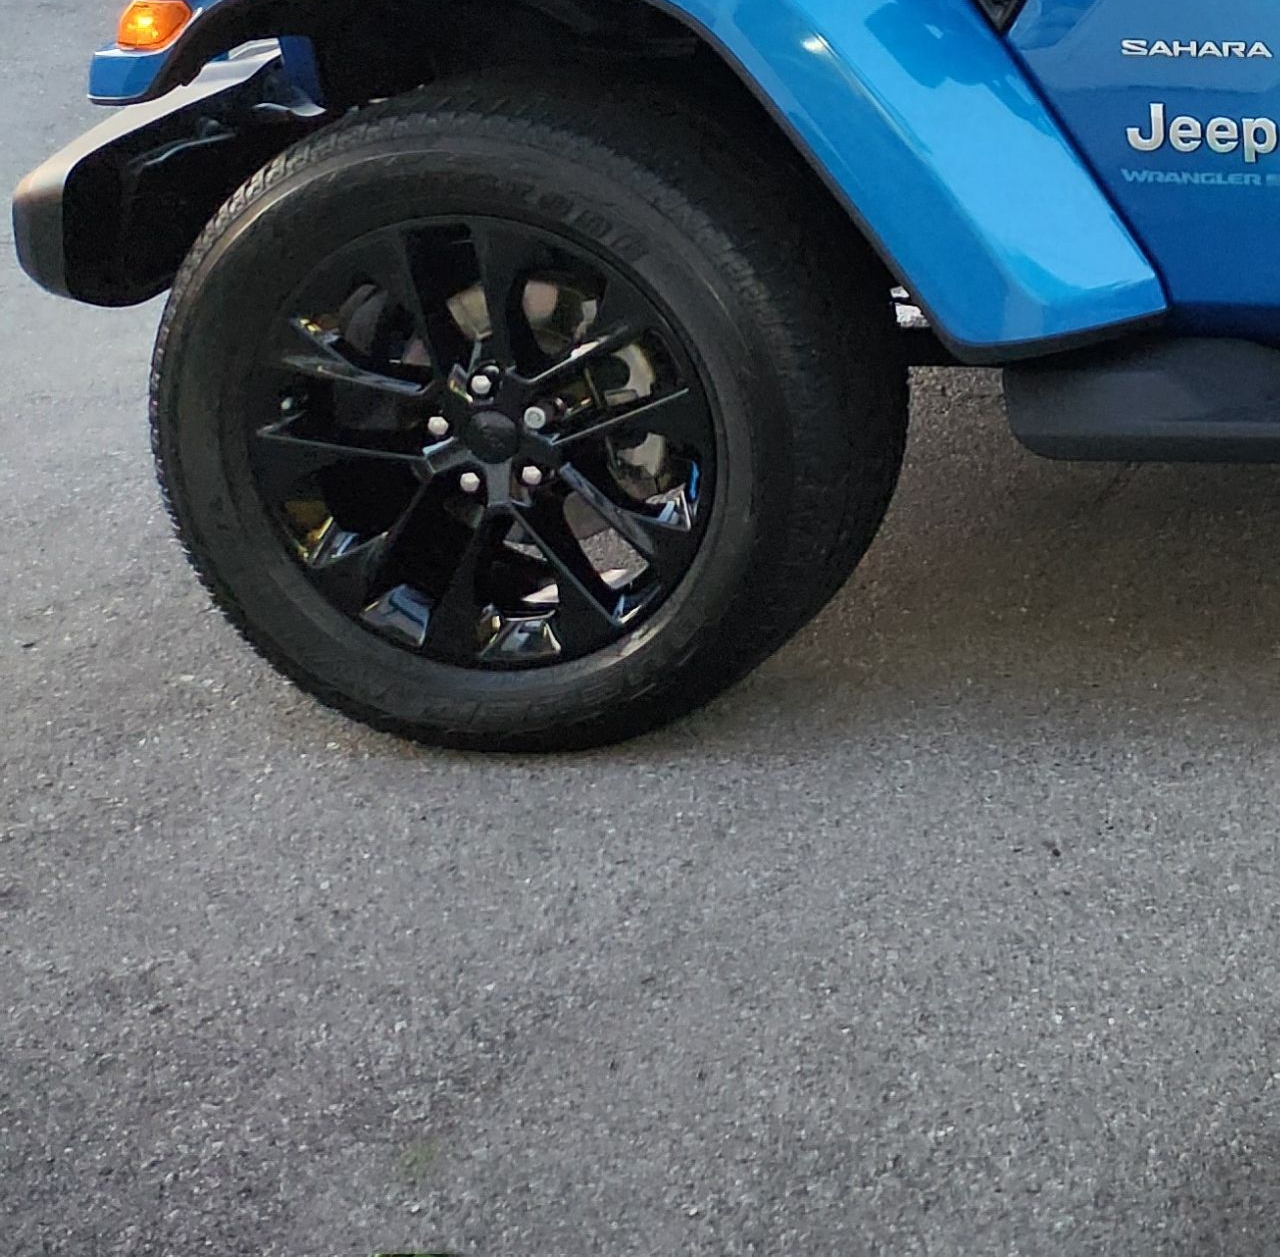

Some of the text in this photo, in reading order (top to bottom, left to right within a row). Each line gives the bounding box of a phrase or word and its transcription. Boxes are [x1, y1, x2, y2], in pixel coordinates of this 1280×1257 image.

[1121, 39, 1273, 58] SAHARA
[1126, 103, 1278, 163] Jeep
[1120, 168, 1262, 186] WRANGLER
